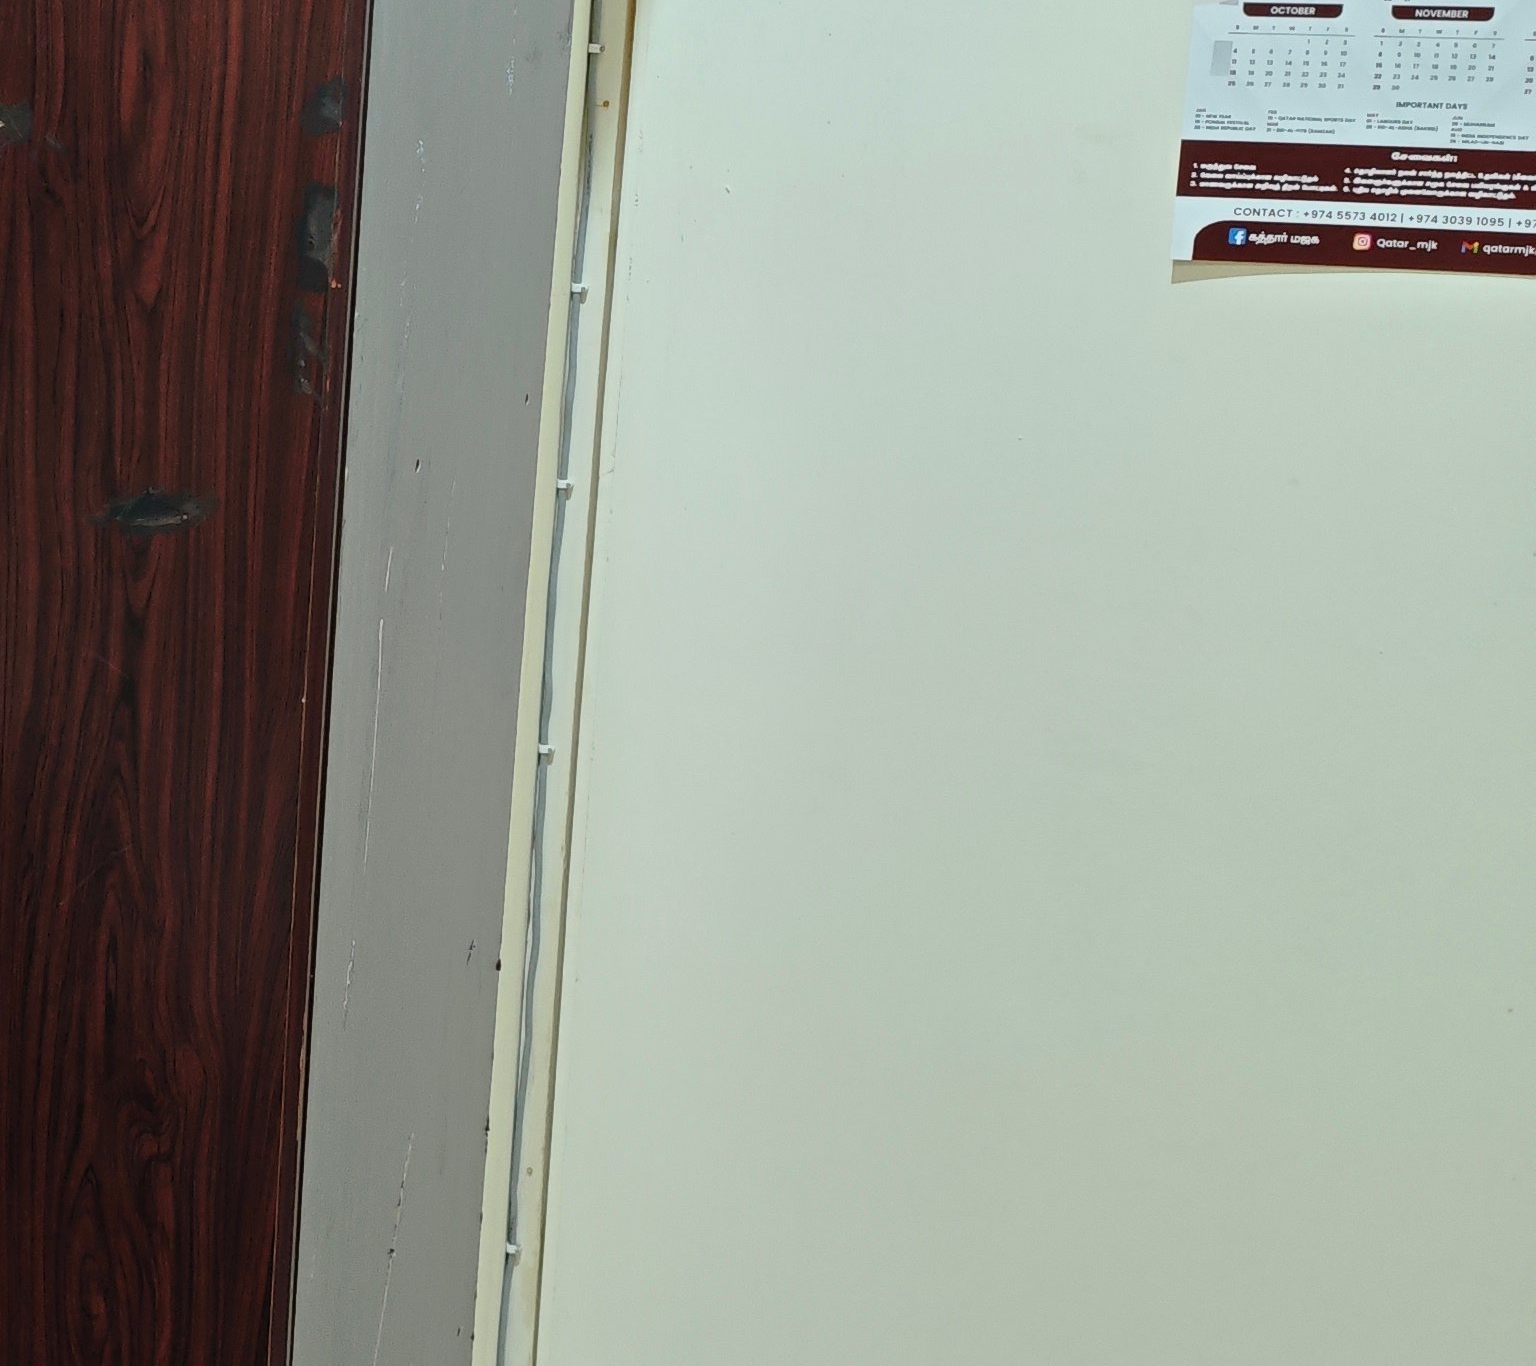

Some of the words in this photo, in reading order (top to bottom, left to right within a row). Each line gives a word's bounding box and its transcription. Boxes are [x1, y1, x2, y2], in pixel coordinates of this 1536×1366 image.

[1270, 6, 1316, 15] OCTOBER
[1415, 9, 1469, 19] NOVEMBER
[1396, 101, 1444, 110] IMPORTANT
[1446, 102, 1468, 110] DAYS
[1233, 207, 1293, 218] CONTACT
[1303, 209, 1333, 219] +974
[1337, 211, 1366, 220] 5573
[1370, 212, 1397, 222] 4012
[1408, 214, 1438, 224] +974
[1442, 215, 1473, 225] 3039
[1476, 216, 1504, 227] 1095
[1376, 238, 1438, 252] Qatar_mjk
[1482, 243, 1536, 257] qatarmjk
